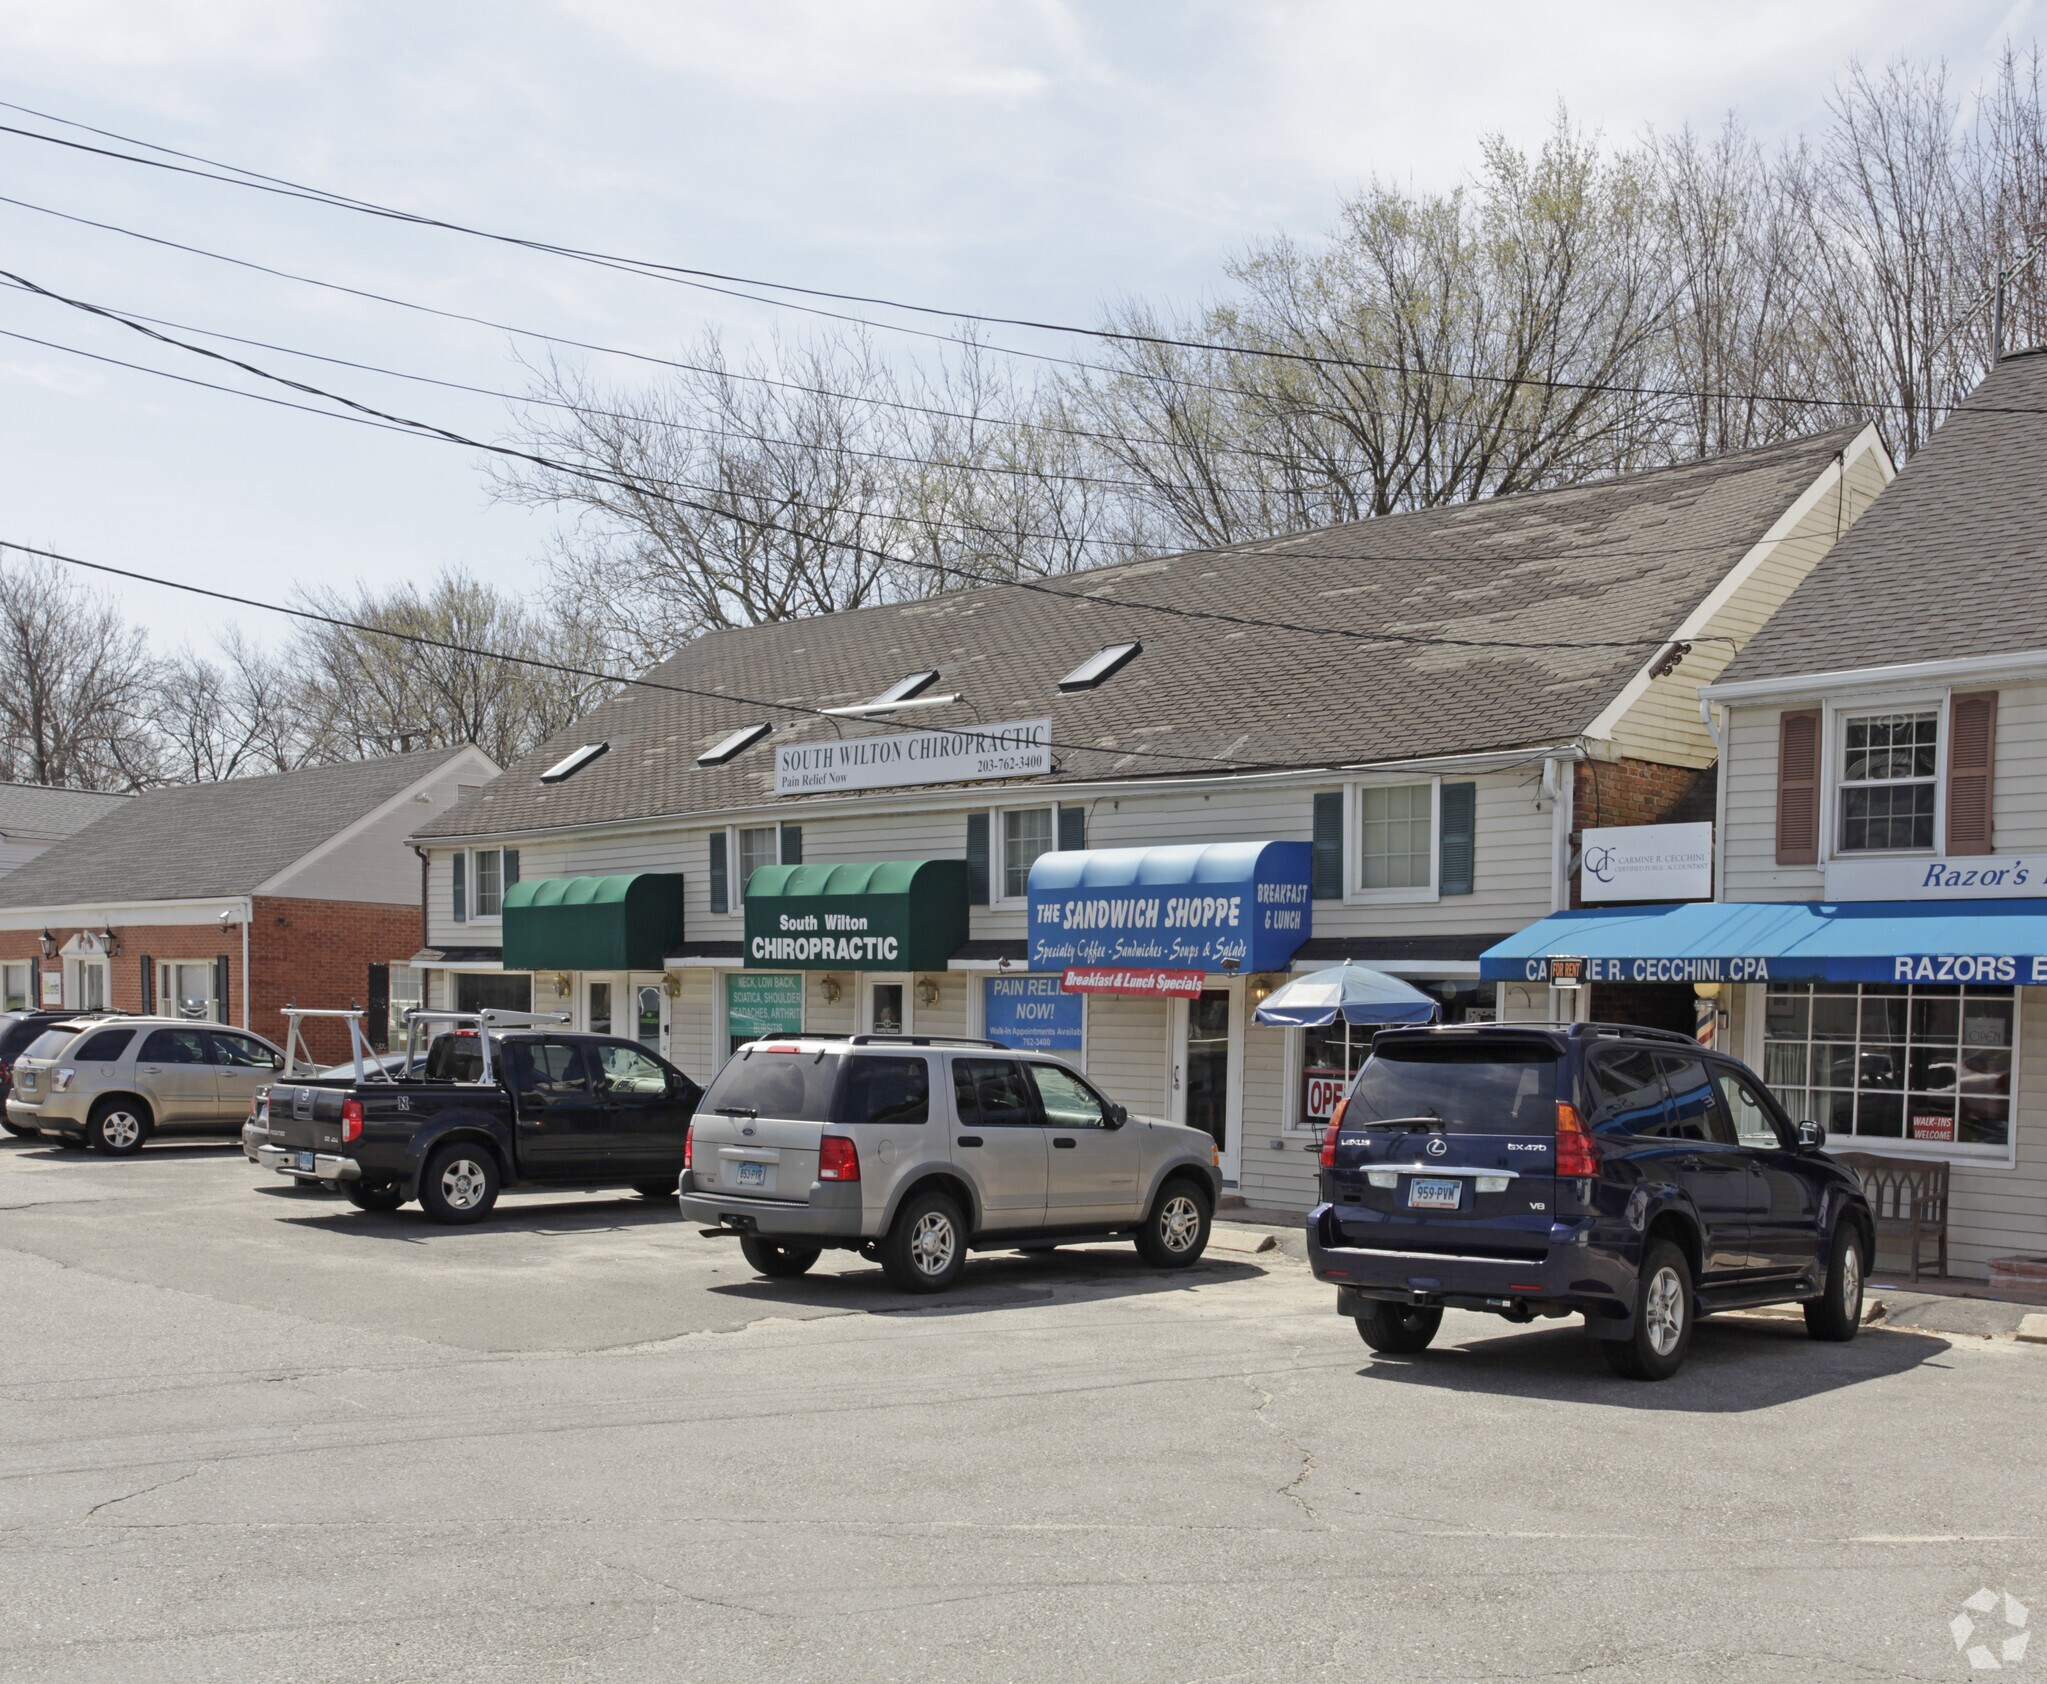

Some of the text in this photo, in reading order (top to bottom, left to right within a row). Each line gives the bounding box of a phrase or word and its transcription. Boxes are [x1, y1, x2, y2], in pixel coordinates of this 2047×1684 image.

[782, 725, 1044, 772] SOUTH WILTON CHIROPRACTIC
[977, 754, 1043, 773] 203-762-3400
[781, 772, 847, 788] Pain Relief Now
[1618, 853, 1705, 865] CARMINE R. CECCHINI
[1615, 862, 1709, 873] CERTIFIED PUBLIC ACCOUNTANT
[1922, 860, 2029, 887] Razor's
[1257, 883, 1308, 904] BREAKFAST
[1036, 896, 1241, 930] THE SANDWICH SHOPPE
[1264, 910, 1301, 930] & LUNCH
[779, 914, 868, 931] South Wilton
[752, 936, 898, 960] CHIROPRACTIC
[1033, 938, 1076, 965] Specialty
[1077, 939, 1105, 966] Coffee
[1111, 937, 1162, 961] Sandwiches
[1169, 937, 1199, 964] Soups
[1203, 941, 1210, 957] &
[1212, 936, 1247, 961] Salads
[1552, 962, 1581, 978] FOR RENT
[1608, 959, 1625, 981] R.
[1730, 957, 1769, 981] CPA
[1894, 956, 2016, 981] RAZORS
[738, 976, 796, 989] NECK, LOW BACK,
[993, 980, 1023, 996] PAIN
[1065, 971, 1202, 992] Breakfast & Lunch Specials
[733, 991, 763, 1004] SCIATICA,
[1016, 1003, 1055, 1020] NOW!
[990, 1026, 1011, 1036] Walk-In
[1012, 1026, 1056, 1038] Appointments
[1023, 1037, 1051, 1046] 762-3400
[1913, 1116, 1952, 1127] WALK-INS
[1341, 1138, 1370, 1146] LEXUS
[1914, 1129, 1951, 1140] WELCOME
[1529, 1202, 1546, 1211] V8
